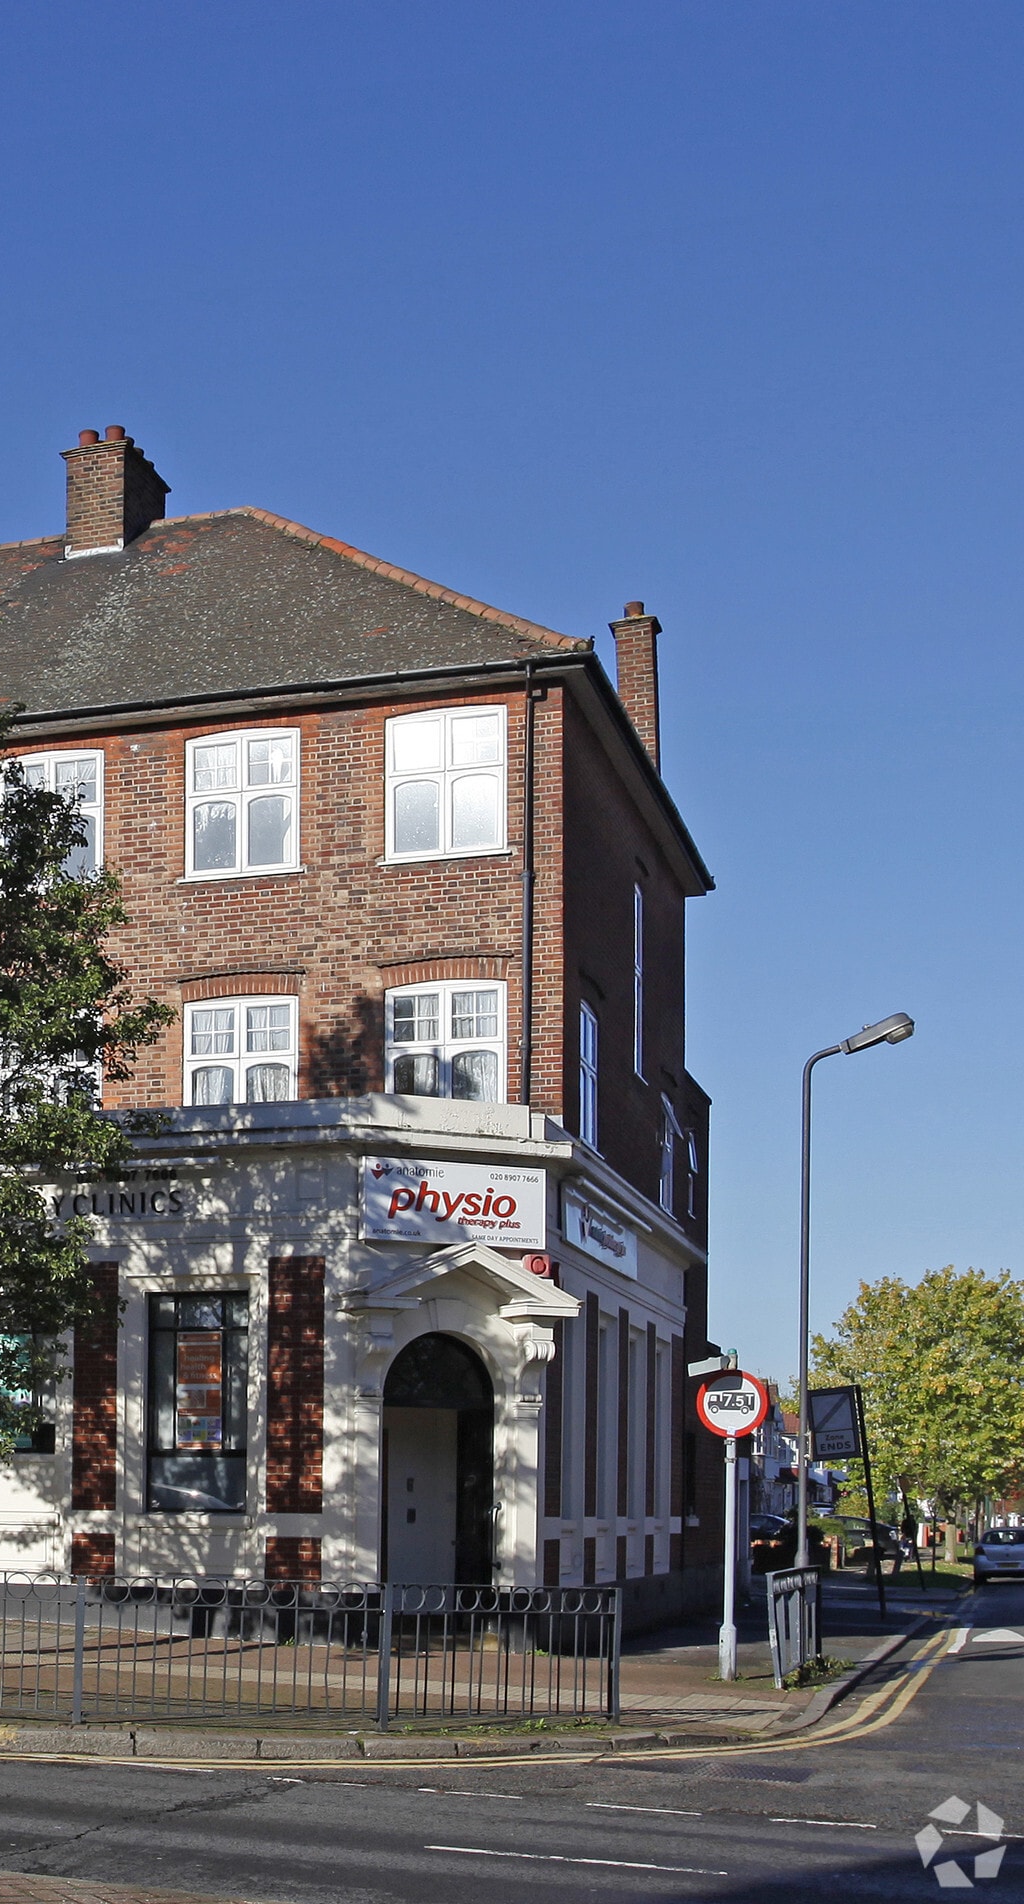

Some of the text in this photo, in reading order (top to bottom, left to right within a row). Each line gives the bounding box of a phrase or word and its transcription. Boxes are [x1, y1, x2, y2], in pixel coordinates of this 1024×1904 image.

[396, 1166, 445, 1178] anatomie
[504, 1174, 521, 1182] 8907
[522, 1175, 539, 1183] 7666
[73, 1190, 182, 1216] CLINICS
[387, 1180, 517, 1222] physio
[457, 1216, 521, 1230] therapy plus
[372, 1228, 422, 1236] anatomie.co.uk
[499, 1236, 539, 1244] APPOINTMENTS
[825, 1433, 845, 1441] Zone
[820, 1441, 852, 1451] ENDS
